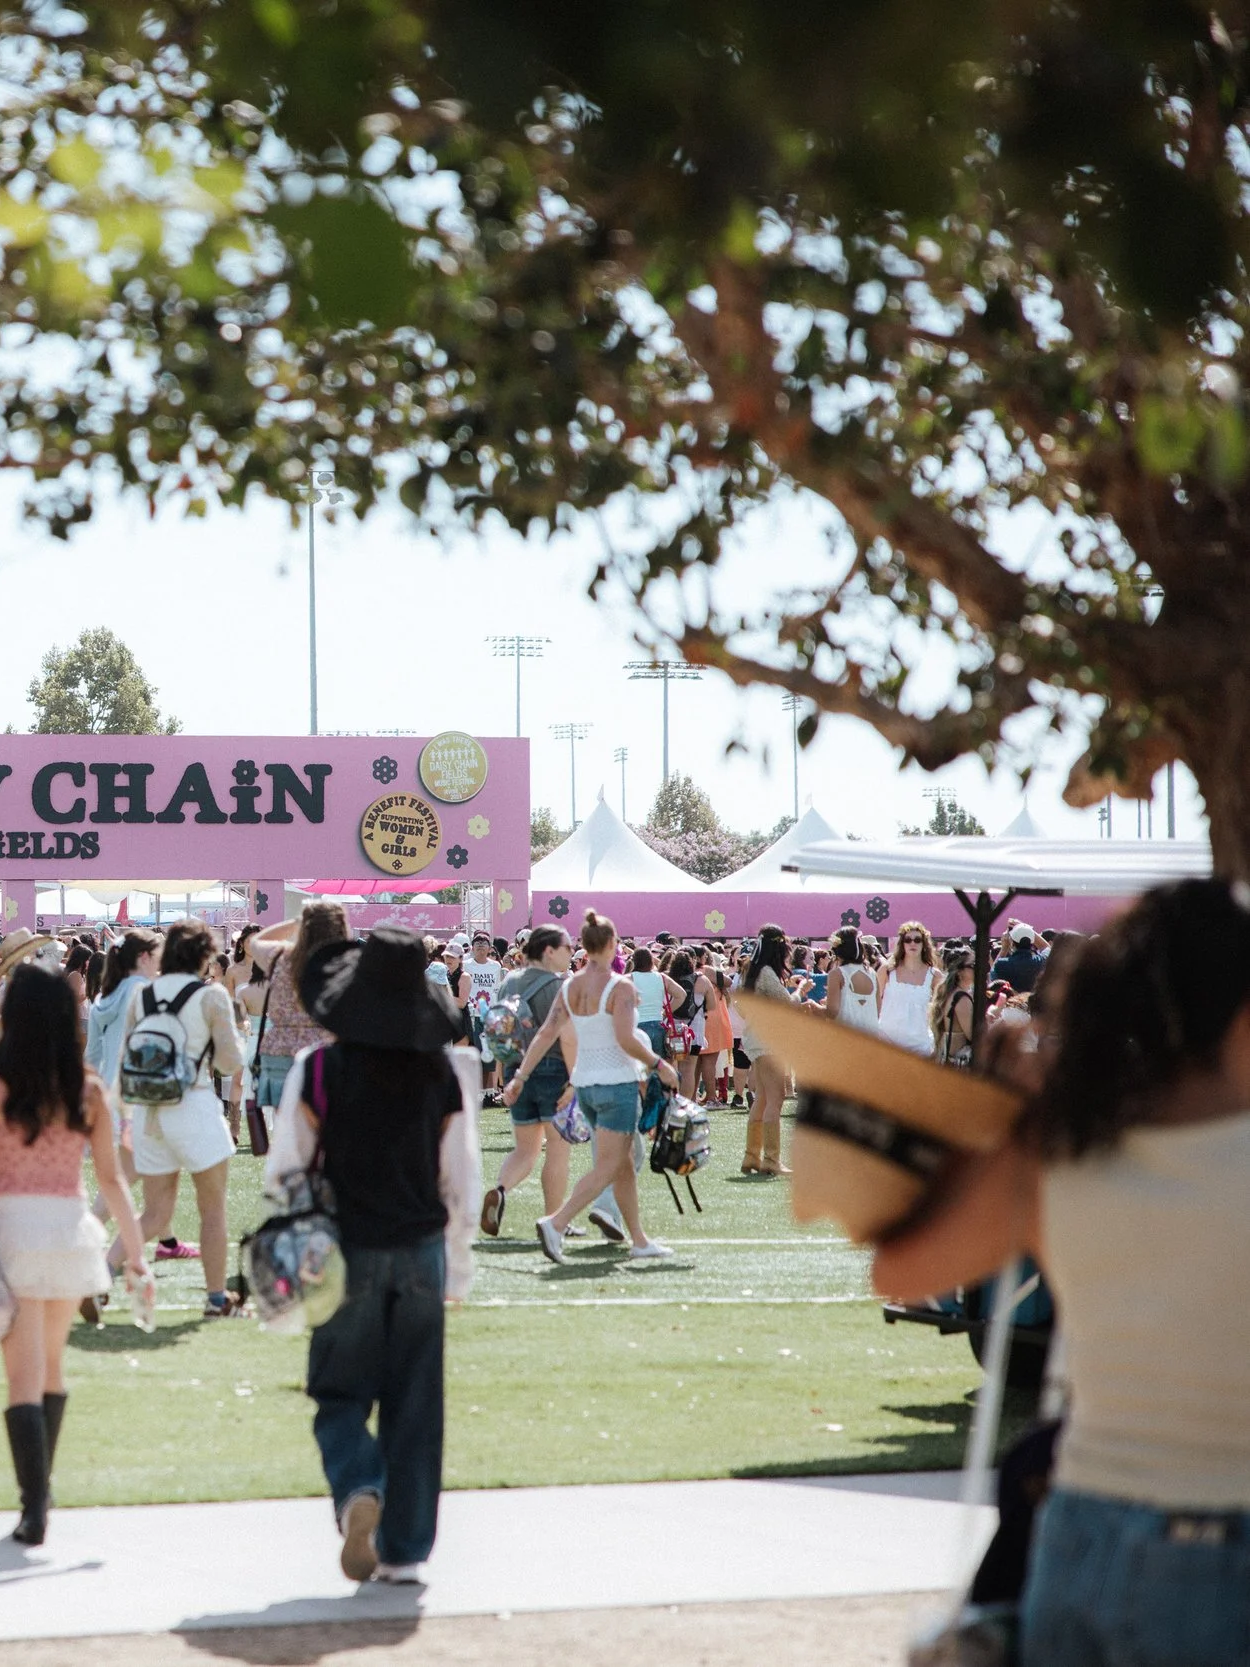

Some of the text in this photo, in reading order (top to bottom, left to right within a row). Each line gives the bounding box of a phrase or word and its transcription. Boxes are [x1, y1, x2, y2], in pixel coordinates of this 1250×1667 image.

[430, 761, 452, 772] DAISY
[441, 768, 468, 779] FIELDS
[364, 796, 438, 849] A BENEFIT FESTIVAL
[380, 813, 424, 825] SUPPORTING
[379, 821, 424, 837] WOMEN
[395, 834, 405, 845] &
[381, 843, 417, 857] GIRLS
